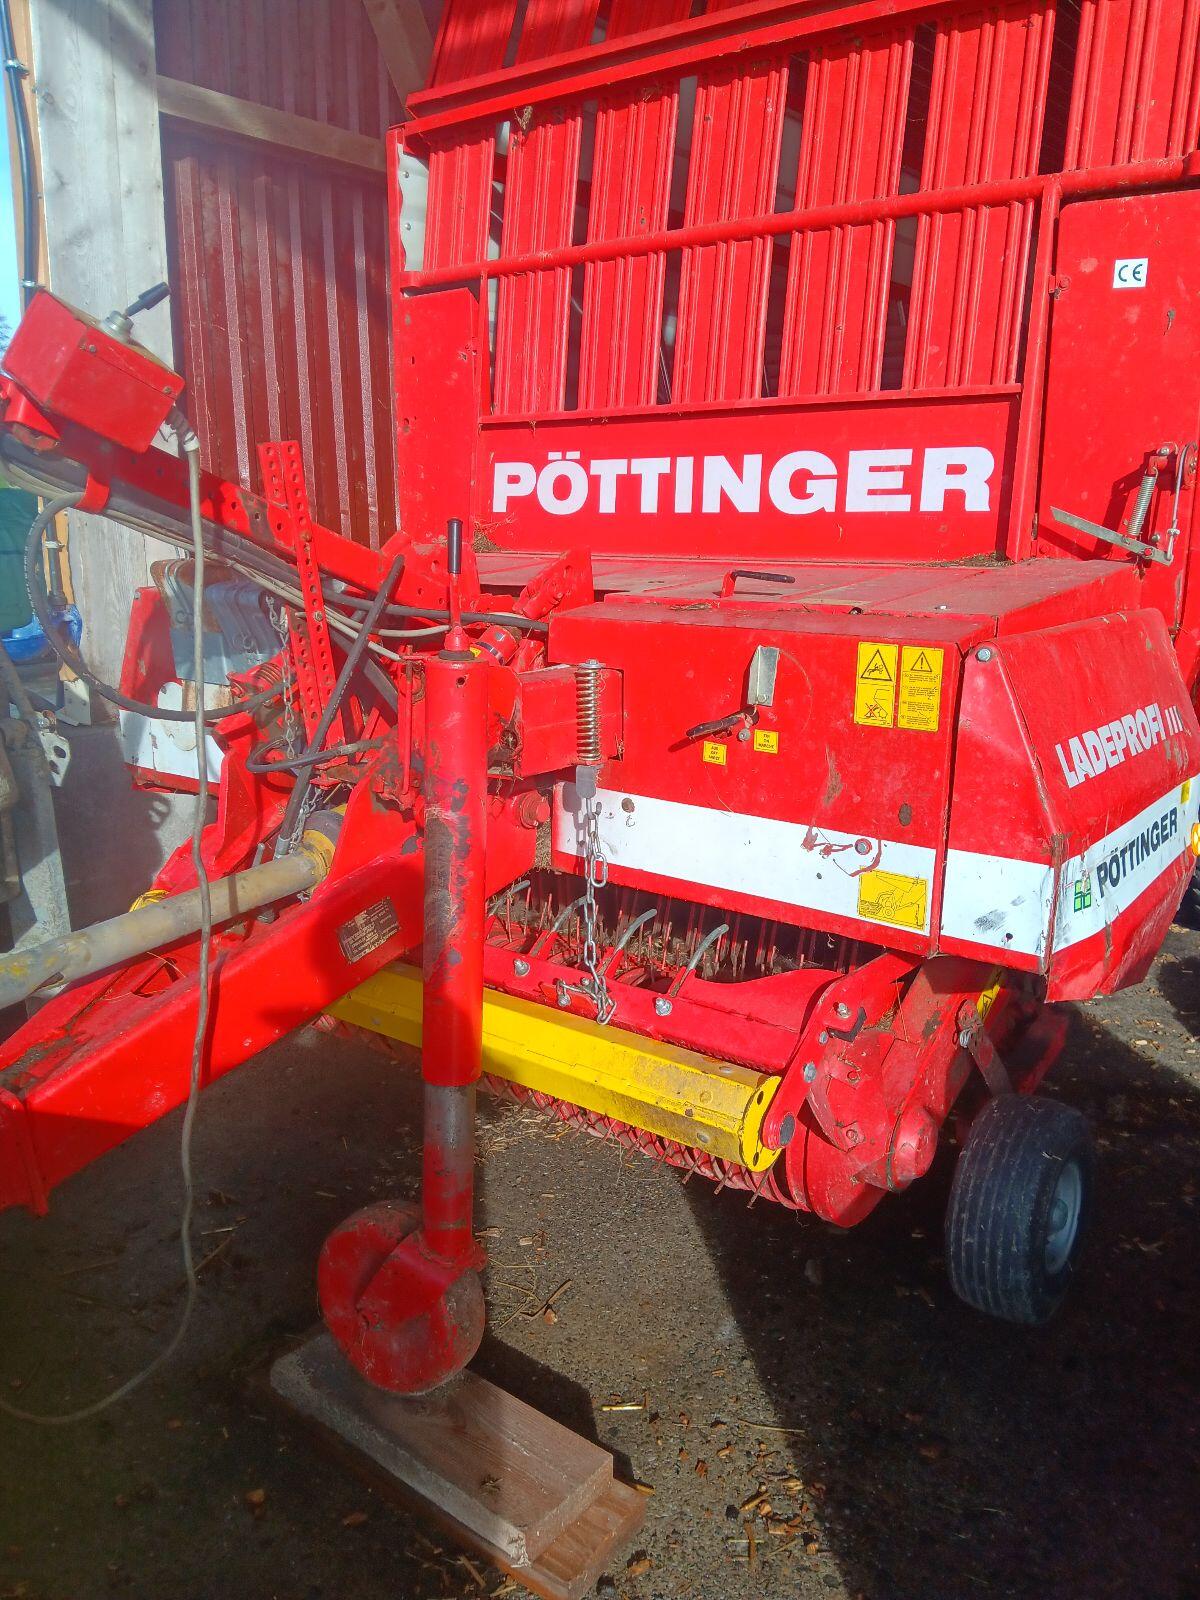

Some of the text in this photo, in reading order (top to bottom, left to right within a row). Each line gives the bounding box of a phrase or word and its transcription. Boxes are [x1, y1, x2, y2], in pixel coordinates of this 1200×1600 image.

[1118, 263, 1143, 282] CE
[492, 446, 995, 516] PÖTTINGER
[1055, 703, 1184, 788] LADEPROFI III
[1096, 806, 1178, 898] PÖTTINGER
